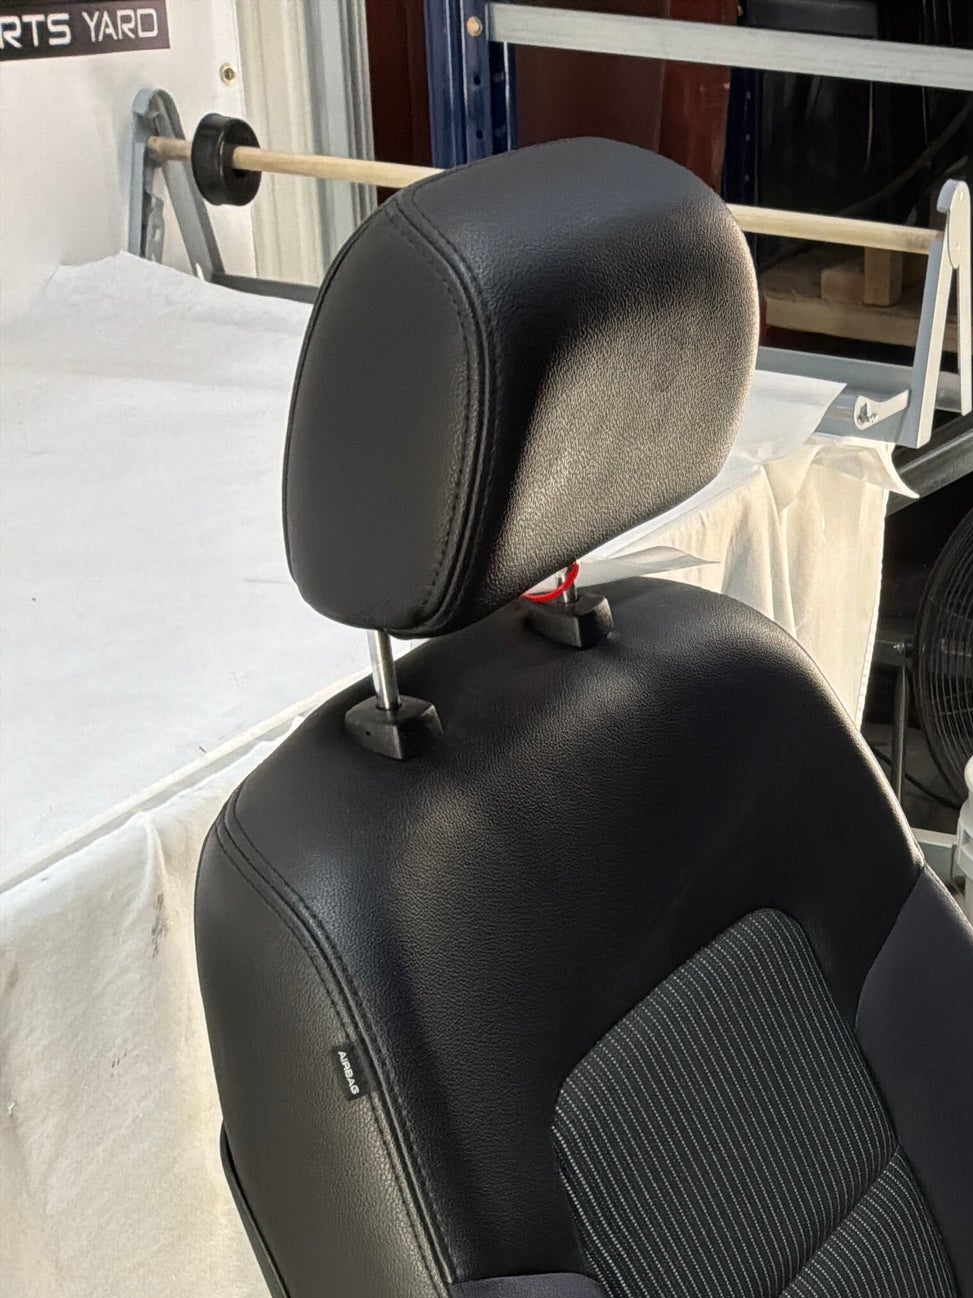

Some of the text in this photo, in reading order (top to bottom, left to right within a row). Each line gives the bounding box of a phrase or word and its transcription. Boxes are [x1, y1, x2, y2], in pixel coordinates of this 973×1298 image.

[0, 8, 158, 49] RTS YARD
[337, 1051, 360, 1095] AIRBAG
